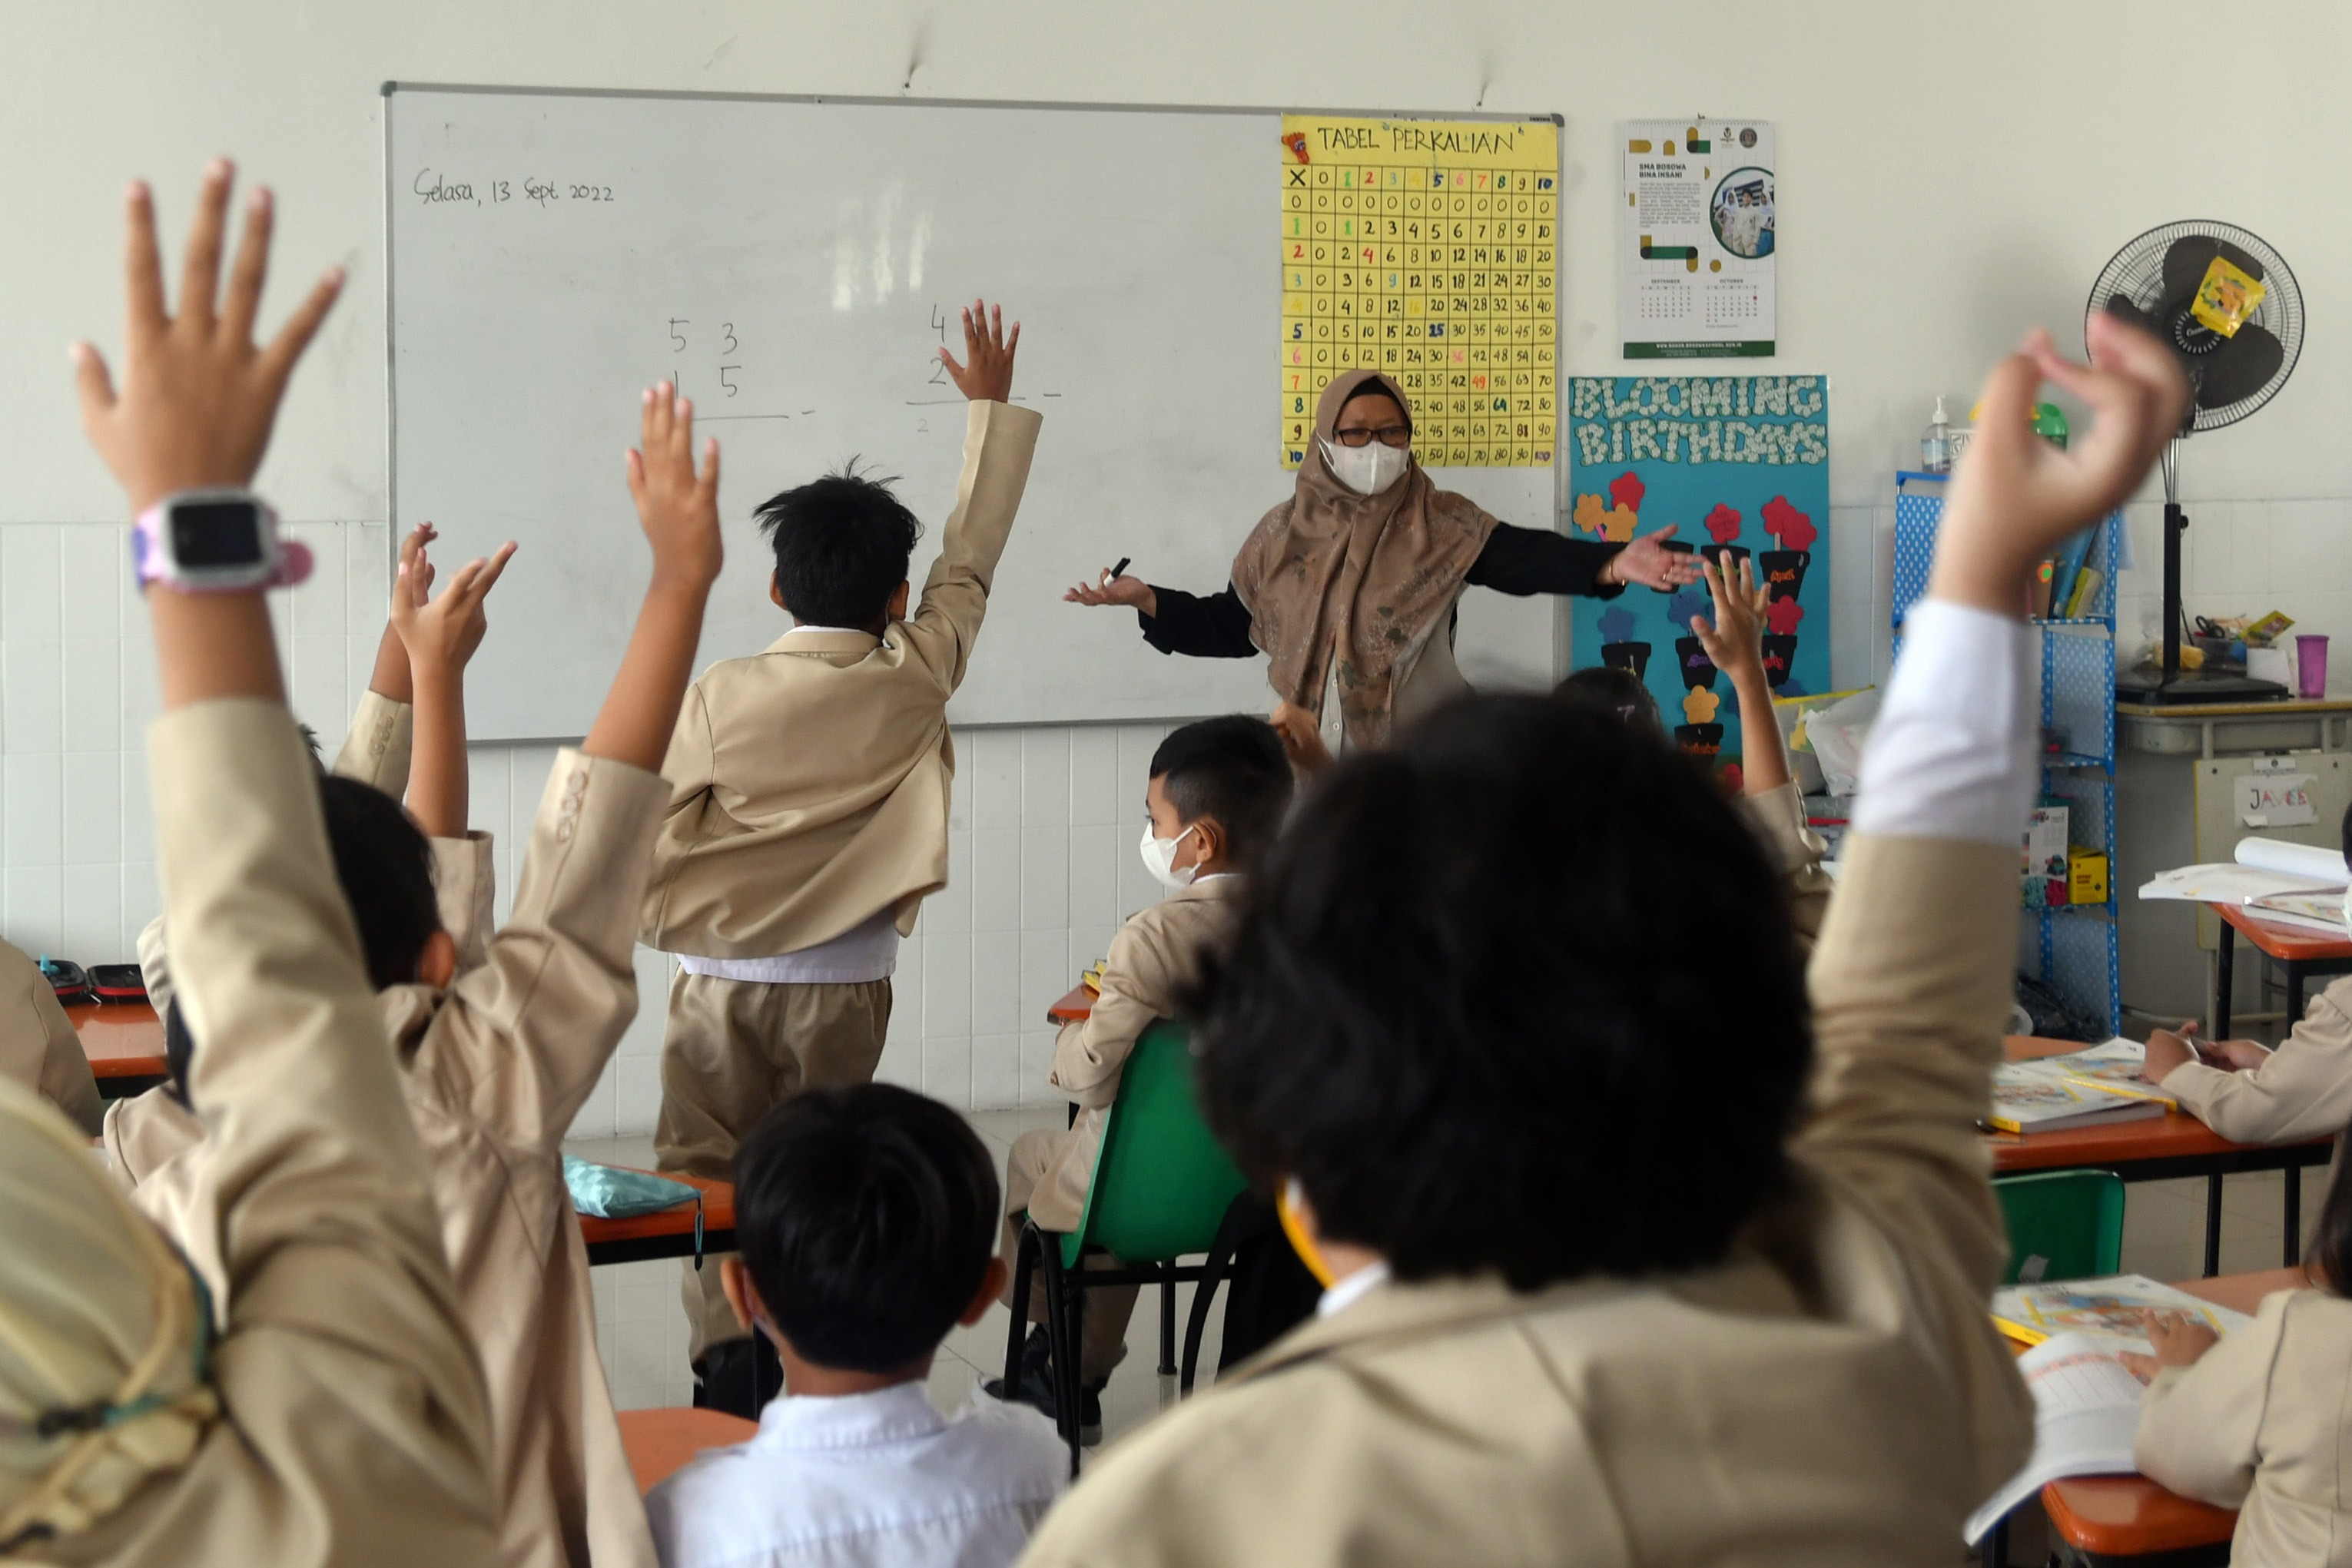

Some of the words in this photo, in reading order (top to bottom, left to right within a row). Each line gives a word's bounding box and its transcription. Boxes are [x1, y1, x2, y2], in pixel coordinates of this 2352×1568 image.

[1318, 128, 1380, 151] TABEL
[1392, 128, 1513, 154] PERKALIAN
[414, 168, 482, 207] Selasa,
[493, 181, 510, 203] 13
[569, 184, 614, 201] 2022
[1319, 172, 1329, 184] 0
[1345, 171, 1351, 187] 1
[1365, 171, 1374, 184] 2
[1391, 172, 1397, 185] 3
[1433, 172, 1444, 187] 5
[1456, 172, 1465, 186] 6
[1478, 174, 1487, 189] 7
[1498, 176, 1505, 188] 8
[1519, 178, 1525, 191] 9
[1538, 178, 1552, 190] 10
[1292, 195, 1301, 208] 0
[1319, 196, 1327, 207] 0
[1342, 196, 1352, 208] 0
[1366, 197, 1375, 209] 0
[1388, 197, 1398, 209] 0
[1410, 197, 1420, 211] 0
[1432, 197, 1441, 211] 0
[1455, 199, 1465, 212] 0
[1478, 199, 1488, 211] 0
[1498, 199, 1507, 212] 0
[1518, 201, 1528, 213] 0
[1540, 201, 1549, 214] 0
[1294, 217, 1299, 235] 1
[1316, 221, 1326, 234] 0
[1345, 220, 1352, 235] 1
[1365, 221, 1375, 234] 2
[1388, 221, 1397, 234] 3
[1409, 223, 1418, 238] 4
[1431, 224, 1440, 239] 5
[1454, 224, 1462, 238] 6
[1479, 225, 1485, 238] 7
[1498, 223, 1506, 238] 8
[1518, 224, 1525, 238] 9
[1538, 225, 1550, 238] 10
[1294, 244, 1304, 258] 2
[1315, 247, 1325, 260] 0
[1342, 247, 1350, 260] 2
[1363, 248, 1373, 264] 4
[1387, 247, 1395, 261] 6
[1411, 248, 1419, 264] 8
[1431, 250, 1441, 262] 10
[1454, 248, 1465, 263] 12
[1475, 249, 1486, 263] 14
[1496, 249, 1505, 263] 16
[1517, 249, 1527, 263] 18
[1537, 250, 1551, 263] 20
[1295, 273, 1302, 287] 3
[1316, 274, 1326, 286] 0
[1343, 273, 1352, 287] 3
[1365, 273, 1372, 287] 6
[1389, 273, 1397, 287] 9
[1411, 275, 1421, 287] 12
[1432, 275, 1442, 288] 15
[1453, 273, 1465, 288] 18
[1474, 273, 1485, 287] 21
[1494, 273, 1508, 288] 24
[1515, 274, 1529, 287] 27
[1537, 276, 1551, 288] 30
[1318, 299, 1327, 312] 0
[1342, 300, 1350, 315] 4
[1366, 299, 1373, 313] 8
[1388, 300, 1400, 313] 12
[1431, 299, 1444, 311] 20
[1454, 299, 1467, 311] 24
[1473, 297, 1487, 311] 28
[1494, 298, 1508, 311] 32
[1515, 299, 1528, 312] 36
[1538, 299, 1551, 313] 40
[931, 303, 945, 343] 4
[1293, 323, 1303, 339] 5
[1319, 326, 1329, 337] 0
[1343, 325, 1349, 338] 5
[1363, 327, 1374, 338] 10
[1387, 326, 1398, 337] 15
[1405, 325, 1421, 336] 20
[1454, 324, 1465, 336] 30
[1474, 324, 1486, 336] 35
[1494, 324, 1508, 336] 40
[1515, 325, 1530, 338] 45
[1539, 324, 1552, 336] 50
[668, 317, 691, 353] 5
[722, 323, 738, 355] 3
[1293, 347, 1302, 365] 6
[1317, 350, 1327, 362] 0
[1342, 348, 1350, 362] 6
[1362, 350, 1374, 362] 12
[1387, 350, 1397, 363] 18
[1407, 350, 1421, 363] 24
[1429, 350, 1442, 362] 30
[1473, 350, 1486, 362] 42
[1494, 349, 1508, 362] 48
[1517, 350, 1528, 363] 54
[1538, 350, 1552, 361] 60
[928, 357, 947, 385] 2
[720, 366, 741, 397] 5
[1292, 375, 1299, 390] 7
[1317, 376, 1328, 388] 0
[1407, 375, 1421, 387] 28
[1430, 374, 1442, 386] 35
[1451, 376, 1465, 387] 42
[1472, 375, 1486, 390] 49
[1494, 376, 1506, 387] 56
[1516, 374, 1528, 385] 63
[1539, 375, 1551, 387] 70
[1295, 397, 1304, 413] 8
[1430, 401, 1442, 413] 40
[1453, 400, 1465, 413] 48
[1474, 399, 1485, 412] 56
[1518, 400, 1531, 412] 72
[1539, 398, 1551, 410] 80
[1570, 376, 1823, 419] BLOOMING
[1294, 424, 1302, 439] 9
[1430, 424, 1442, 438] 45
[1452, 426, 1465, 437] 54
[1473, 423, 1485, 436] 63
[1495, 424, 1508, 436] 72
[1517, 424, 1528, 437] 81
[1538, 423, 1550, 436] 90
[1575, 419, 1827, 466] BIRTHDAYS
[1290, 450, 1302, 462] 10
[1429, 449, 1442, 460] 50
[1452, 449, 1465, 461] 60
[1475, 450, 1486, 461] 70
[1494, 448, 1508, 460] 80
[1516, 448, 1528, 460] 90
[1535, 450, 1551, 462] 100
